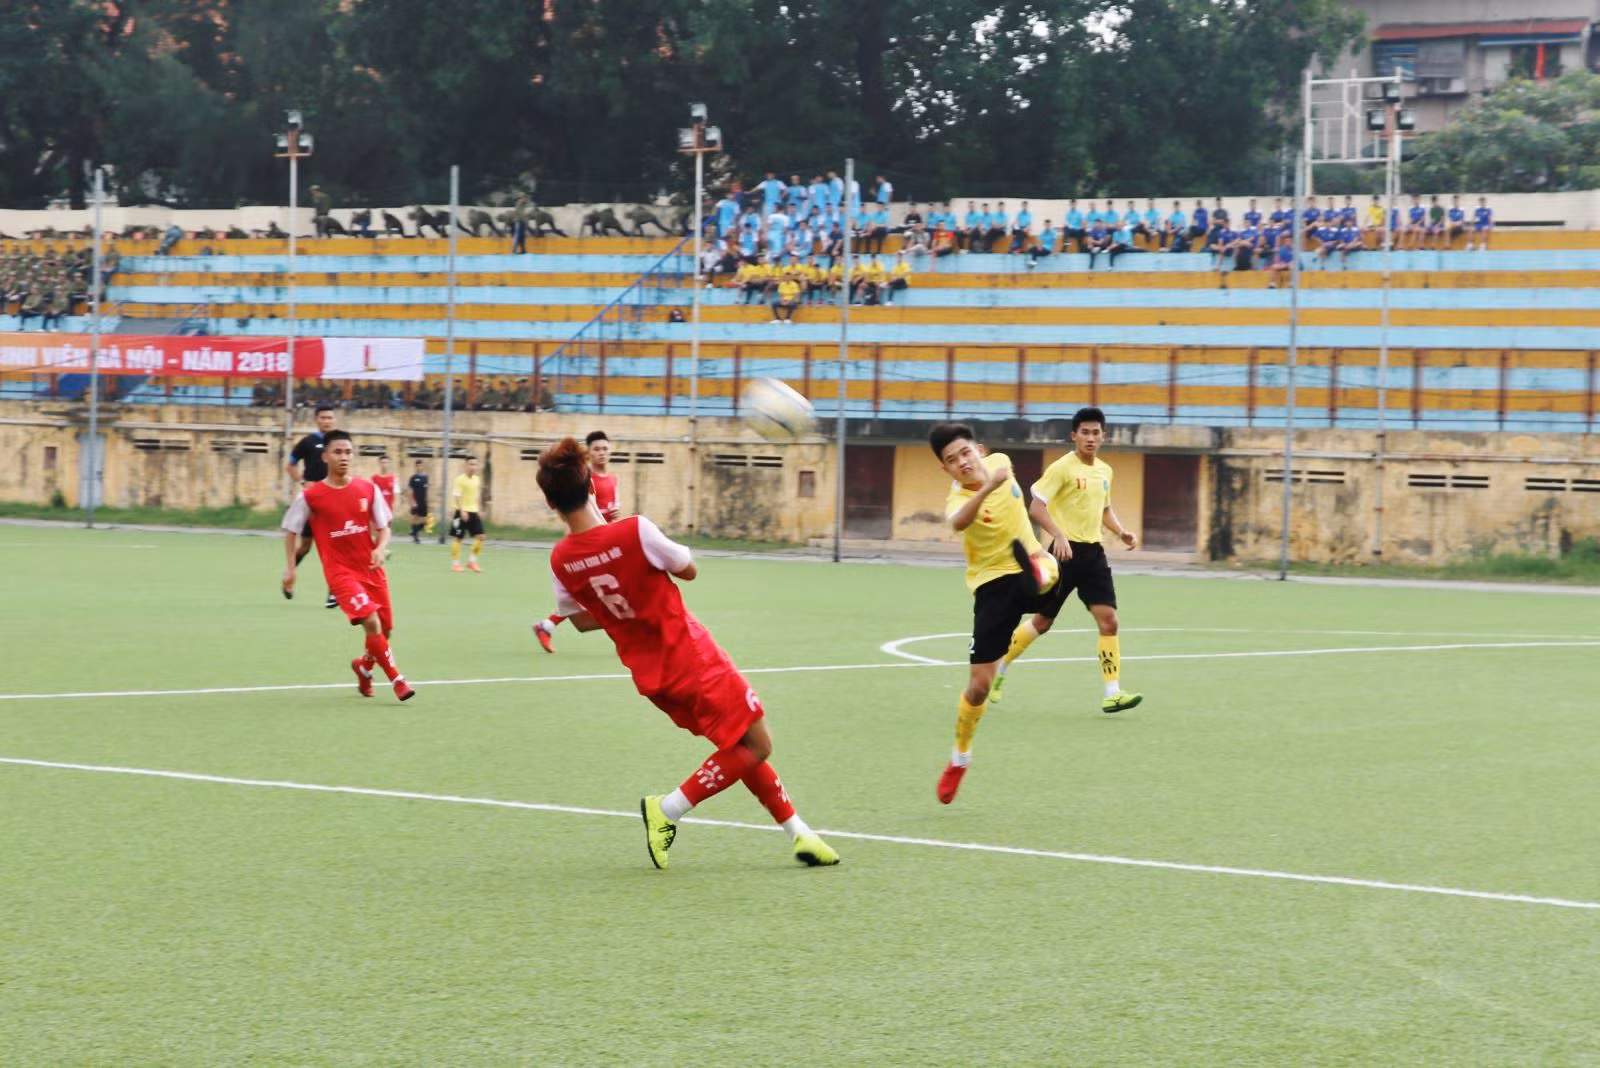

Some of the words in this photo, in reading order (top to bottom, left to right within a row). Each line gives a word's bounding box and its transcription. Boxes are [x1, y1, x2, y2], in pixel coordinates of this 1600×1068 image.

[126, 345, 164, 374] NỘI
[182, 346, 233, 371] NĂM
[237, 351, 289, 372] 2018
[1075, 478, 1087, 490] 17
[350, 593, 369, 611] 17
[589, 573, 636, 620] 6
